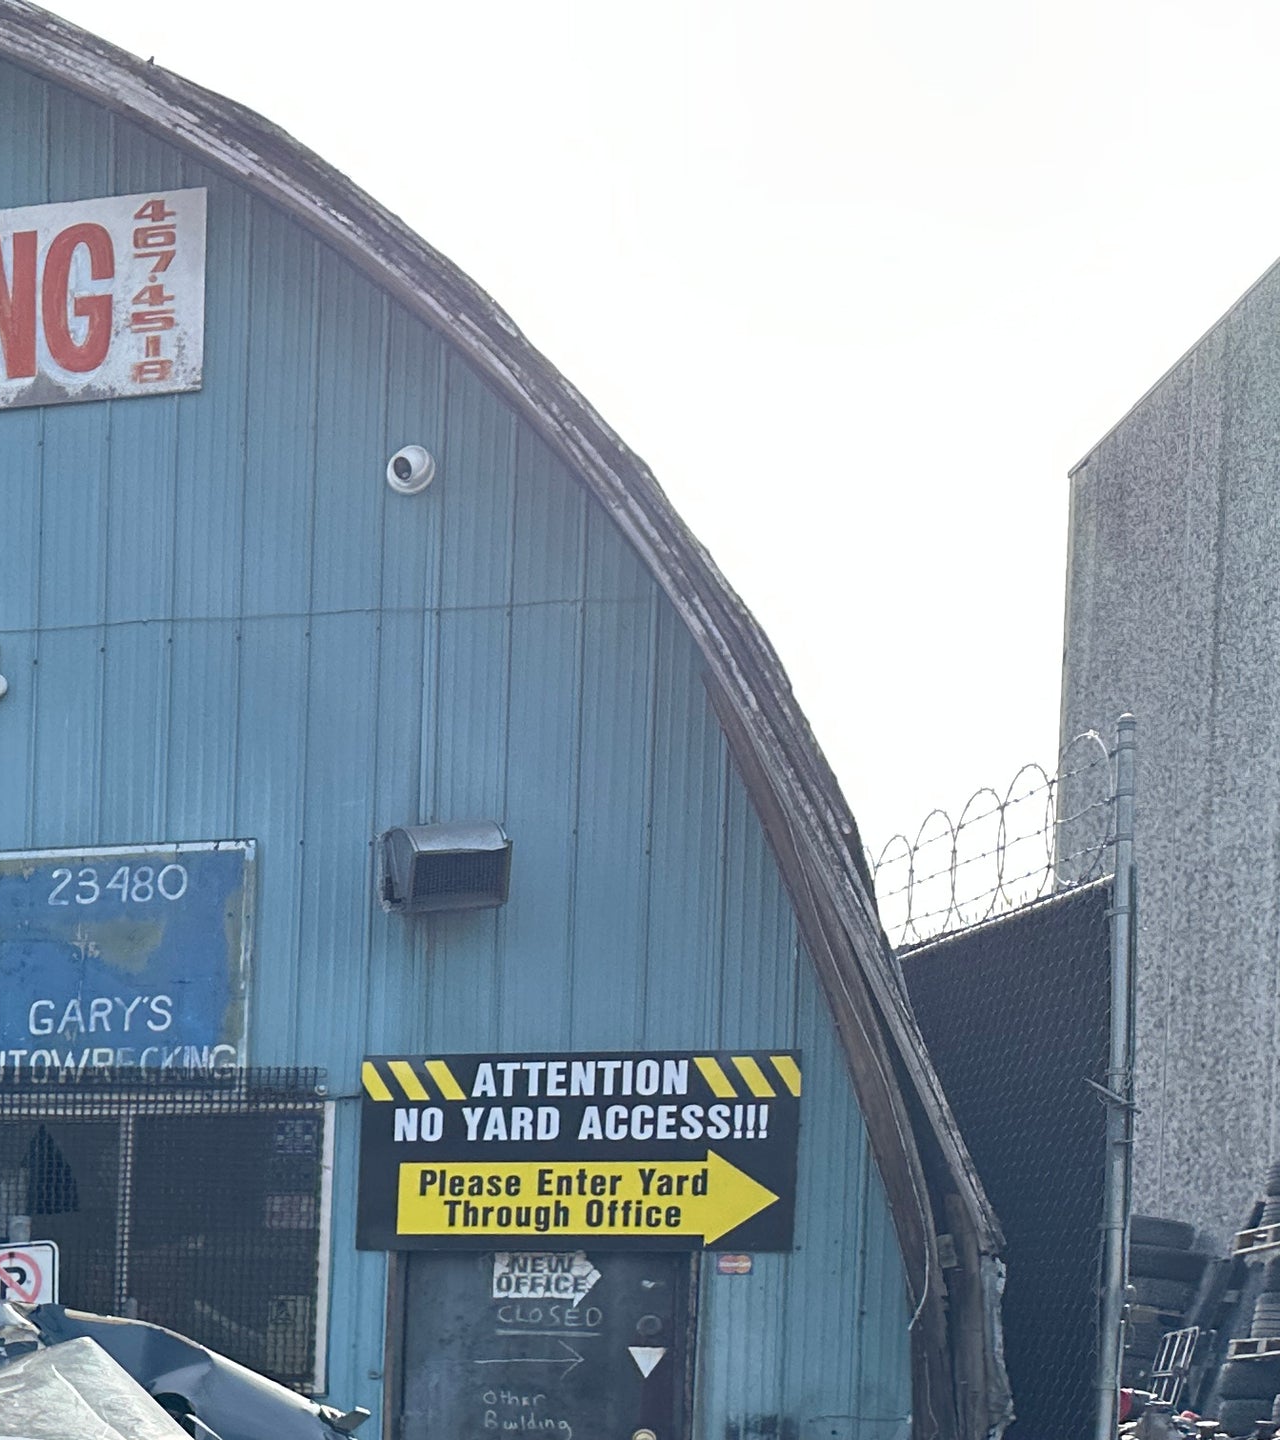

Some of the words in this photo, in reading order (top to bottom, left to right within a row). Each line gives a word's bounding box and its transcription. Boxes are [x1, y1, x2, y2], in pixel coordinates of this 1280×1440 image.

[48, 864, 188, 905] 23480
[28, 995, 172, 1036] GARY'S
[471, 1059, 689, 1098] ATTENTION
[393, 1107, 444, 1142] NO
[463, 1106, 560, 1141] YARD
[578, 1104, 769, 1140] ACCESS!!!
[419, 1169, 521, 1196] Please
[538, 1168, 622, 1196] Enter
[639, 1167, 709, 1196] Yard
[443, 1200, 570, 1232] Through
[585, 1200, 681, 1228] Office
[506, 1253, 575, 1273] NEW
[496, 1274, 589, 1294] OFFICE
[497, 1305, 602, 1327] CLOSED
